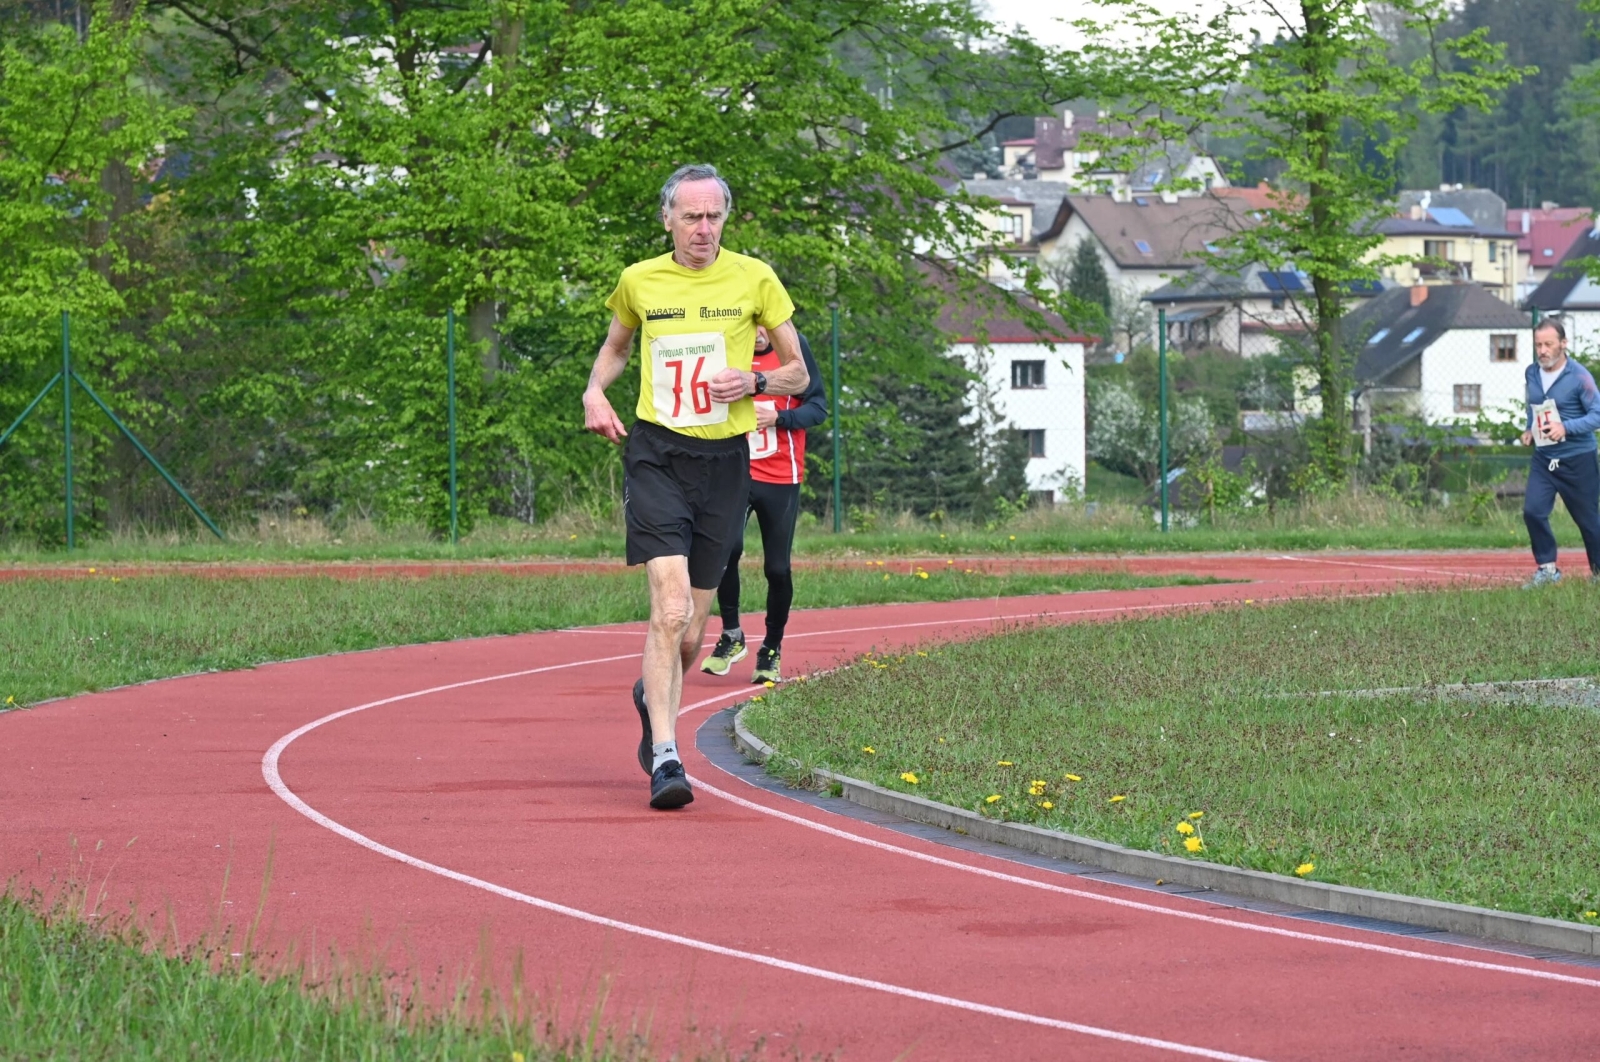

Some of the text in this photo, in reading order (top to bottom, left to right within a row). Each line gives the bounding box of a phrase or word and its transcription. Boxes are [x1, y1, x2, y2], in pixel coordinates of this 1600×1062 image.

[645, 307, 685, 316] MARATON
[700, 306, 742, 318] Krakonoš
[658, 344, 715, 358] PIVOVAR TRUTNOV
[665, 356, 711, 418] 76
